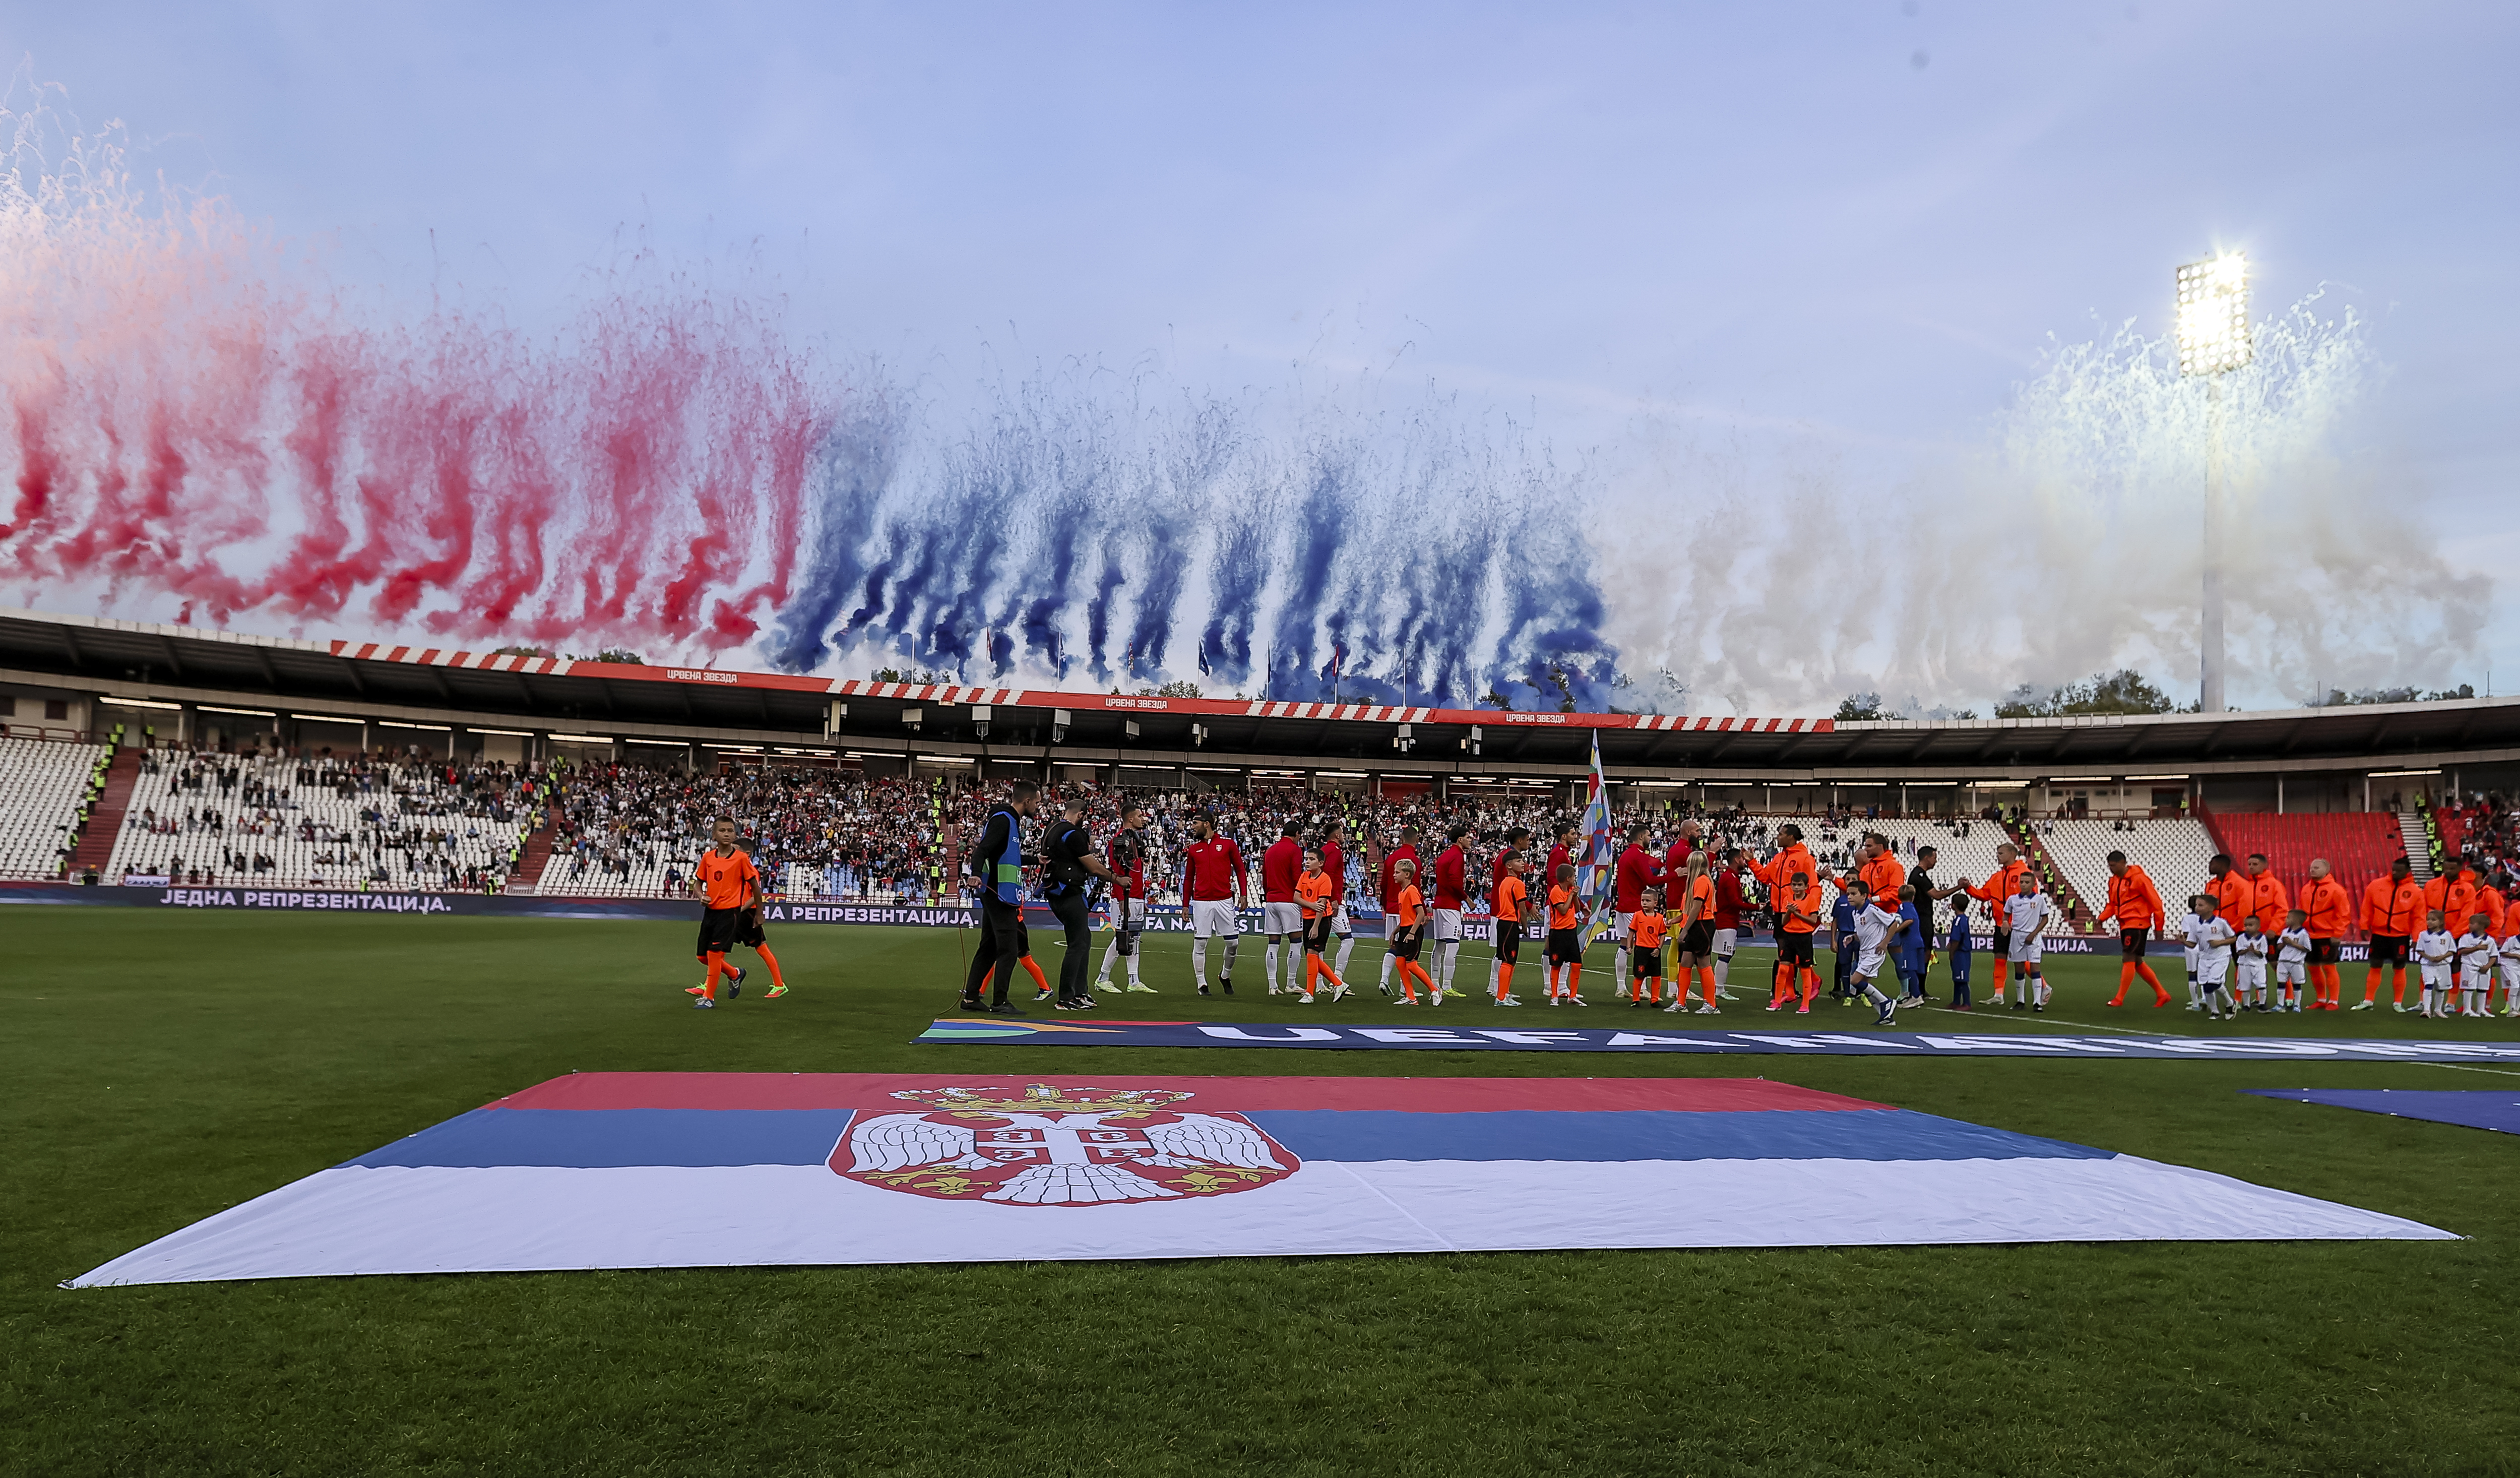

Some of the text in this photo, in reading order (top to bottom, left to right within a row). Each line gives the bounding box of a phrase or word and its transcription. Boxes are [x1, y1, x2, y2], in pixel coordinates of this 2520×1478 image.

[667, 669, 737, 684] ЦРВЕНА ЗВЕЗДА
[1105, 698, 1167, 710] ЦРВЕНА ЗВЕЗДА
[1506, 714, 1565, 724] ЦРВЕНА ЗВЕЗДА
[160, 889, 452, 912] ЈЕДНА РЕПРЕЗЕНТАЦИЈА.
[792, 906, 979, 926] РЕПРЕЗЕНТАЦИЈА.
[1196, 1025, 1751, 1047] UEFA
